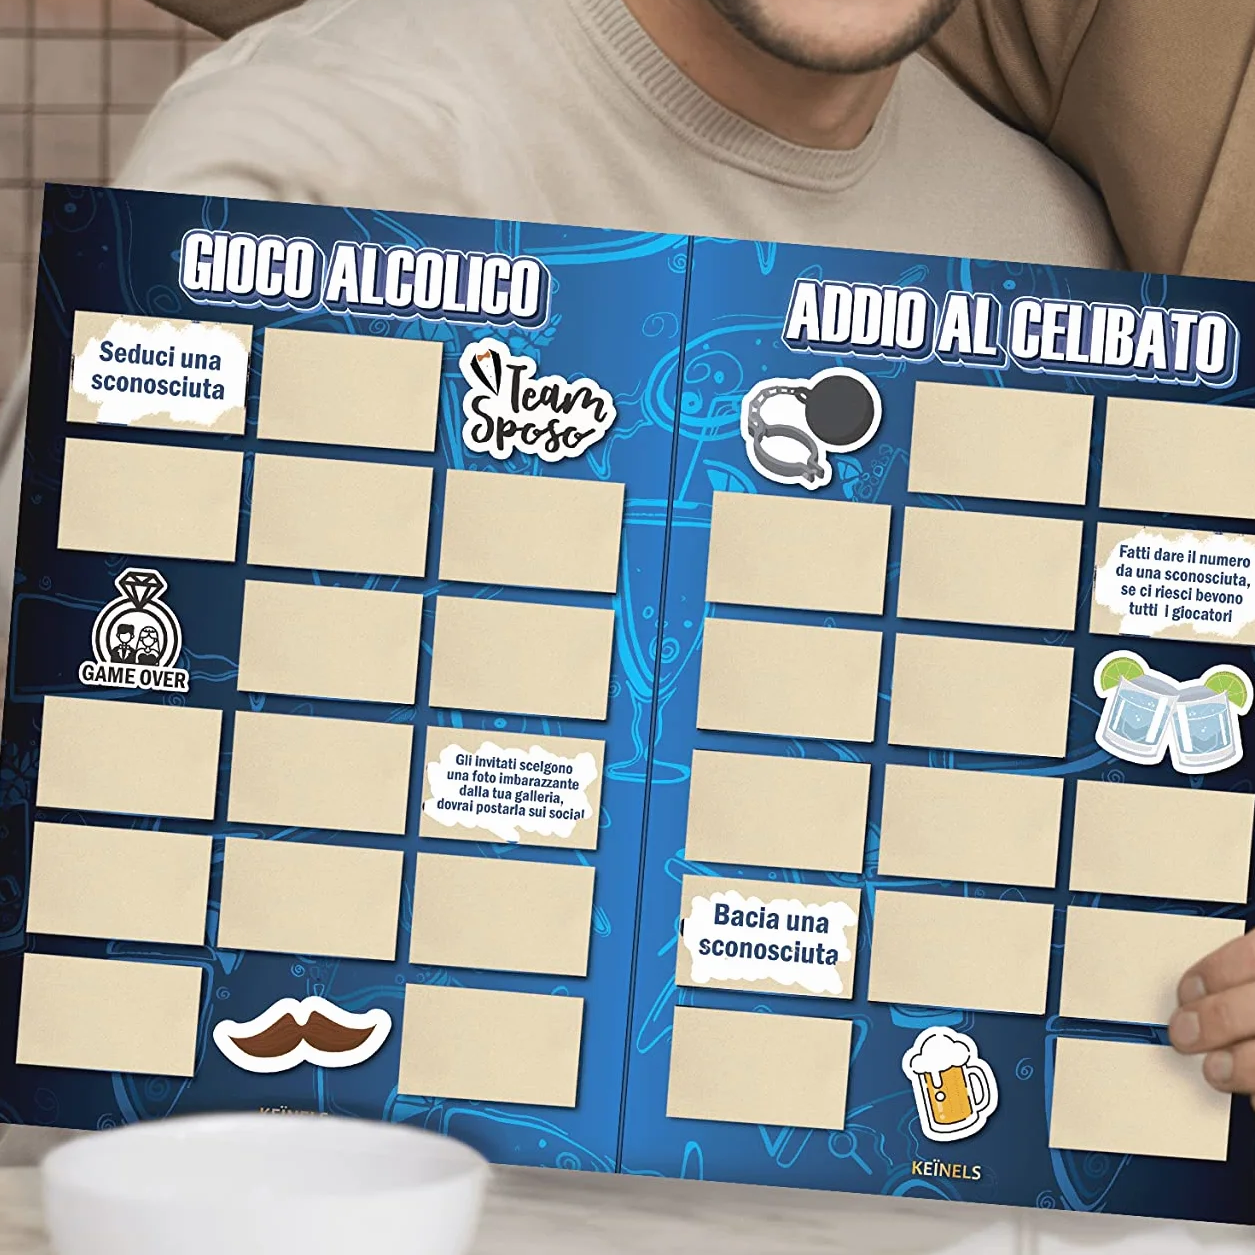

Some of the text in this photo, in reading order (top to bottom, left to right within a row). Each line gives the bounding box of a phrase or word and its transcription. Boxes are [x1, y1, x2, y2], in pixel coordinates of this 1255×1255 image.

[182, 231, 541, 318] GIOCO ALCOLICO
[786, 281, 1228, 375] ADDIO AL CELIBATO
[99, 340, 221, 371] Seduci una
[91, 373, 225, 400] sconosciuta
[506, 364, 608, 423] Team
[471, 395, 596, 453] Sposo
[1119, 544, 1251, 568] Fatti dare il numero
[1116, 564, 1251, 589] da una sconosciuta,
[1121, 584, 1243, 604] se ci riesci bevono
[1129, 601, 1158, 616] tutti
[1172, 606, 1232, 623] giocatori
[82, 664, 186, 688] GAME OVER
[456, 754, 573, 776] Gli invitati scelgono
[447, 770, 580, 790] una foto imbarazzante
[459, 784, 564, 806] dalla tua galleria,
[437, 798, 585, 821] dovrai postarla sui social
[714, 903, 829, 933] Bacia una
[699, 938, 839, 965] sconosciuta
[911, 1158, 982, 1181] KEÏNELS
